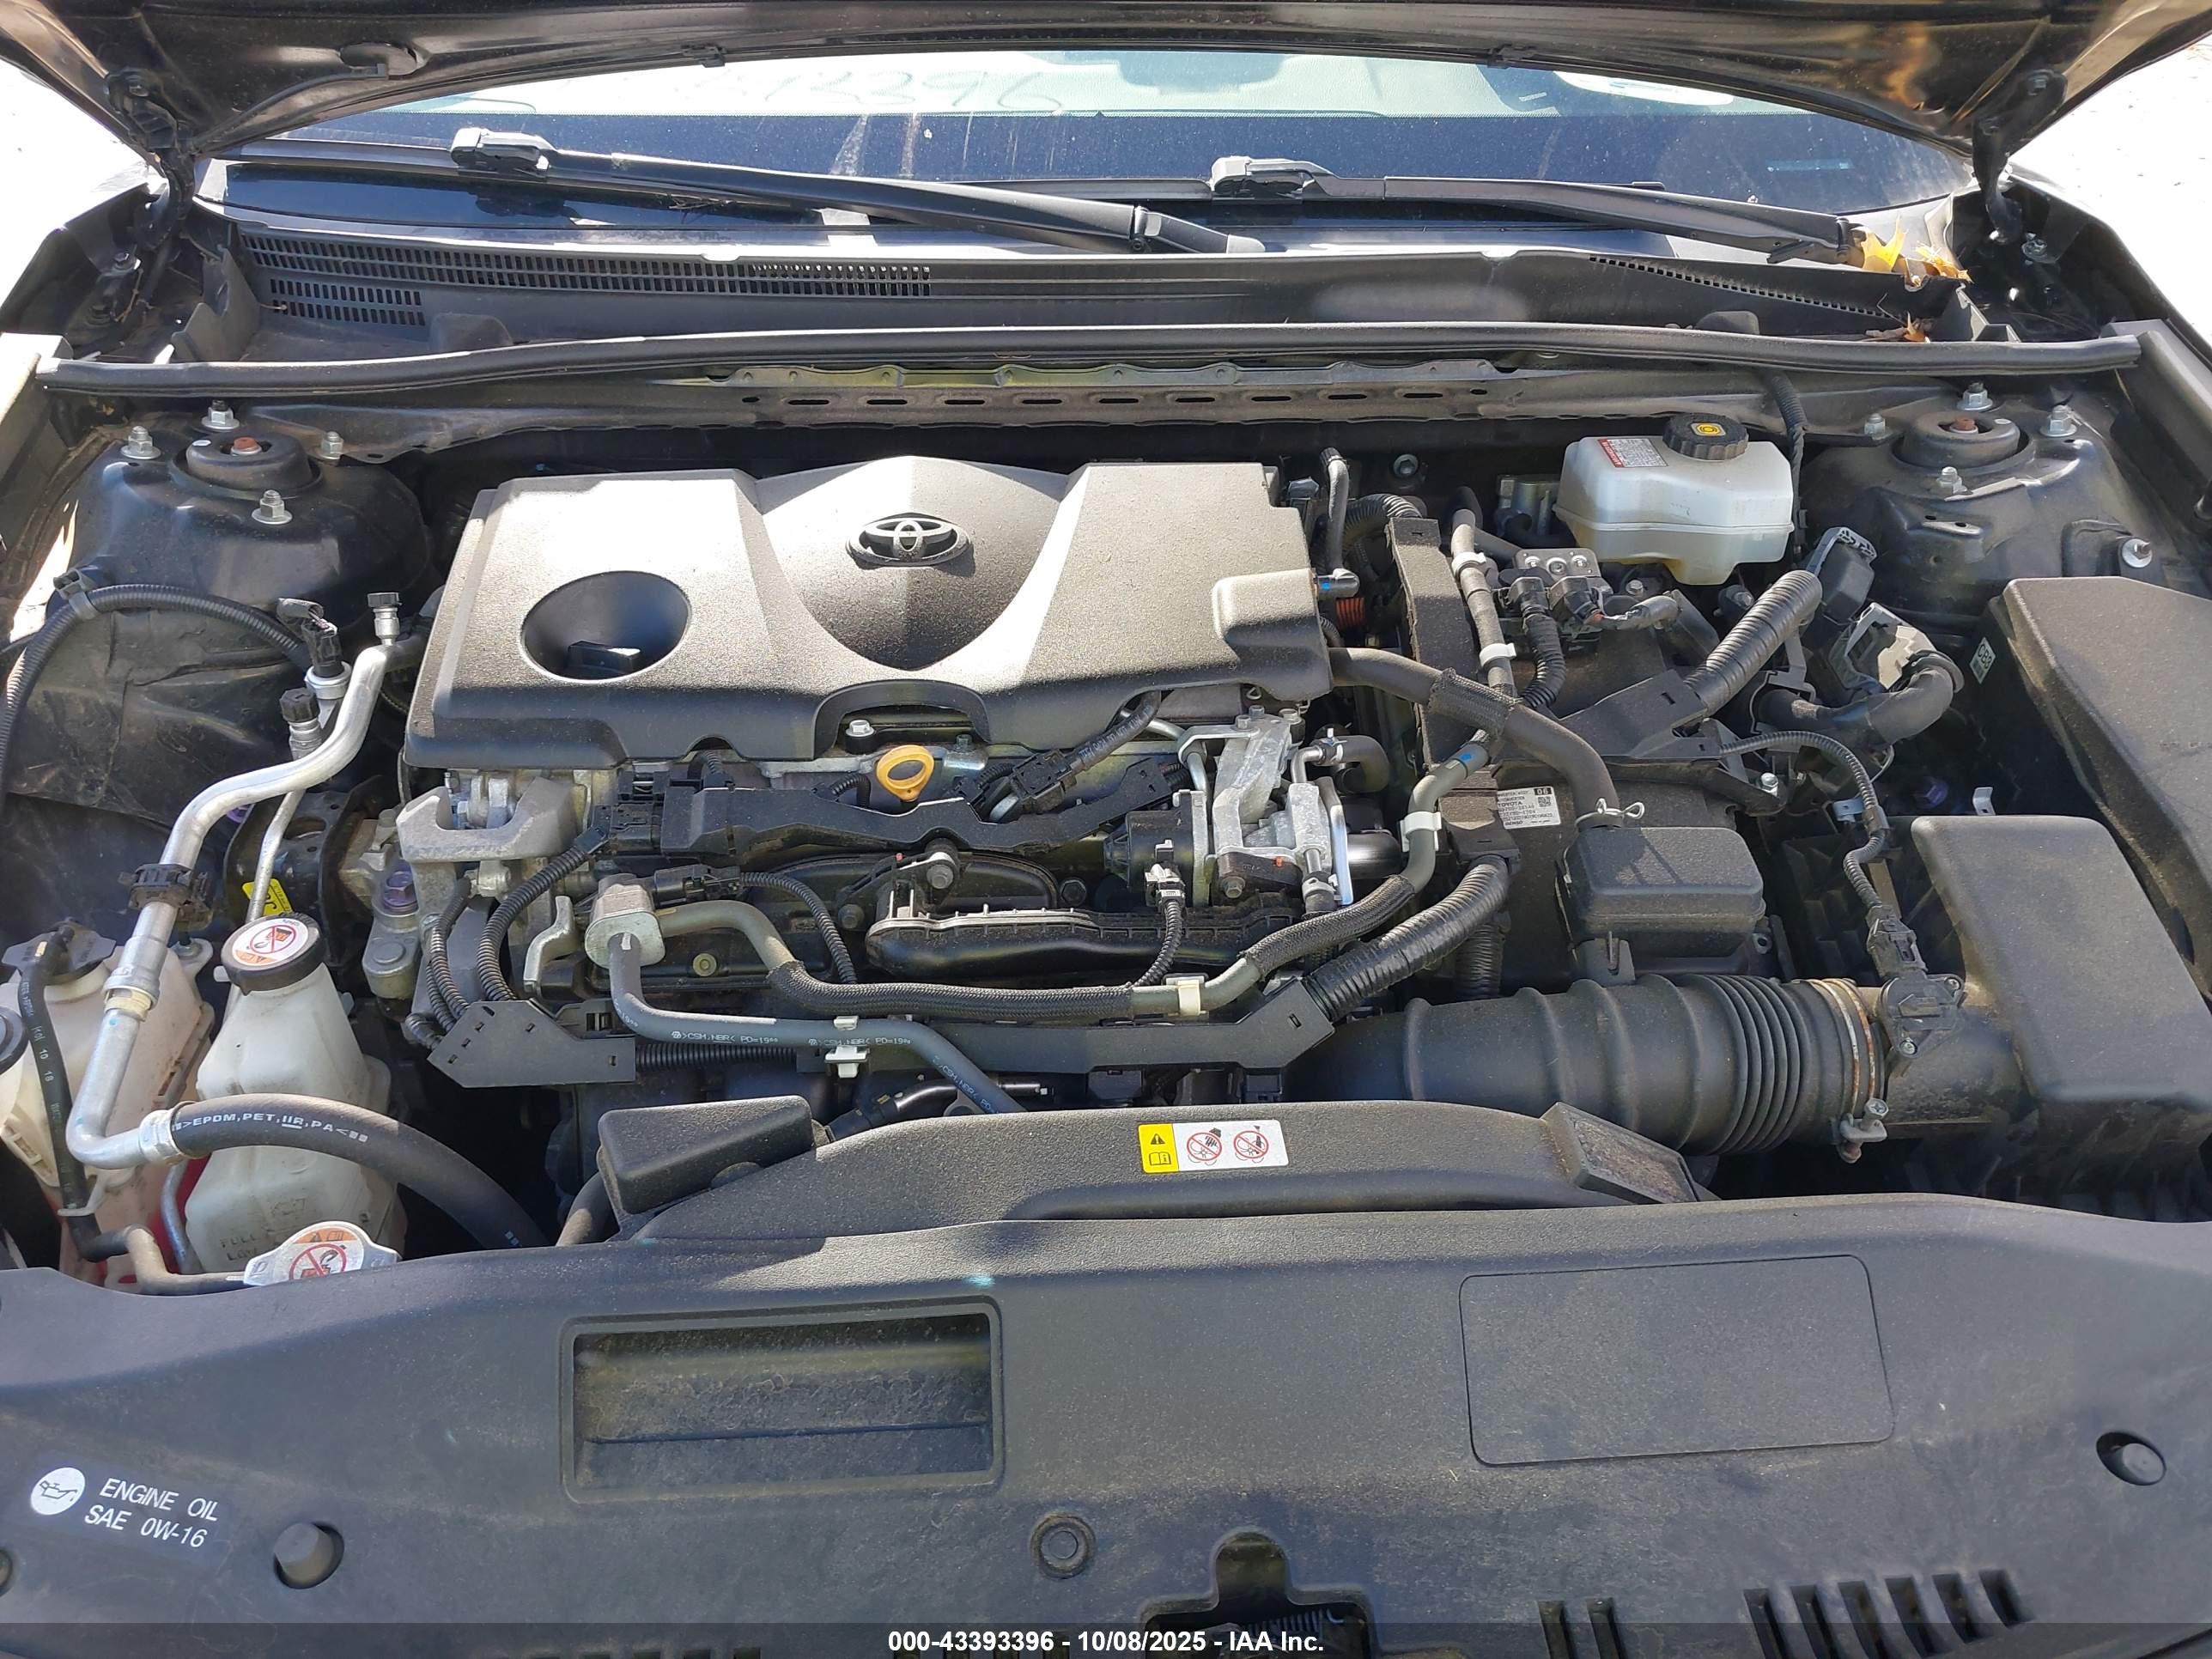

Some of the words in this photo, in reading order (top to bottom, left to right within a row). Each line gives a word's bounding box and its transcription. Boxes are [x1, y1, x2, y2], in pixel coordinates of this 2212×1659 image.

[99, 1478, 179, 1511] ENGINE
[187, 1498, 219, 1522] OIL
[84, 1504, 132, 1530] SAE
[140, 1517, 208, 1547] 0W-16
